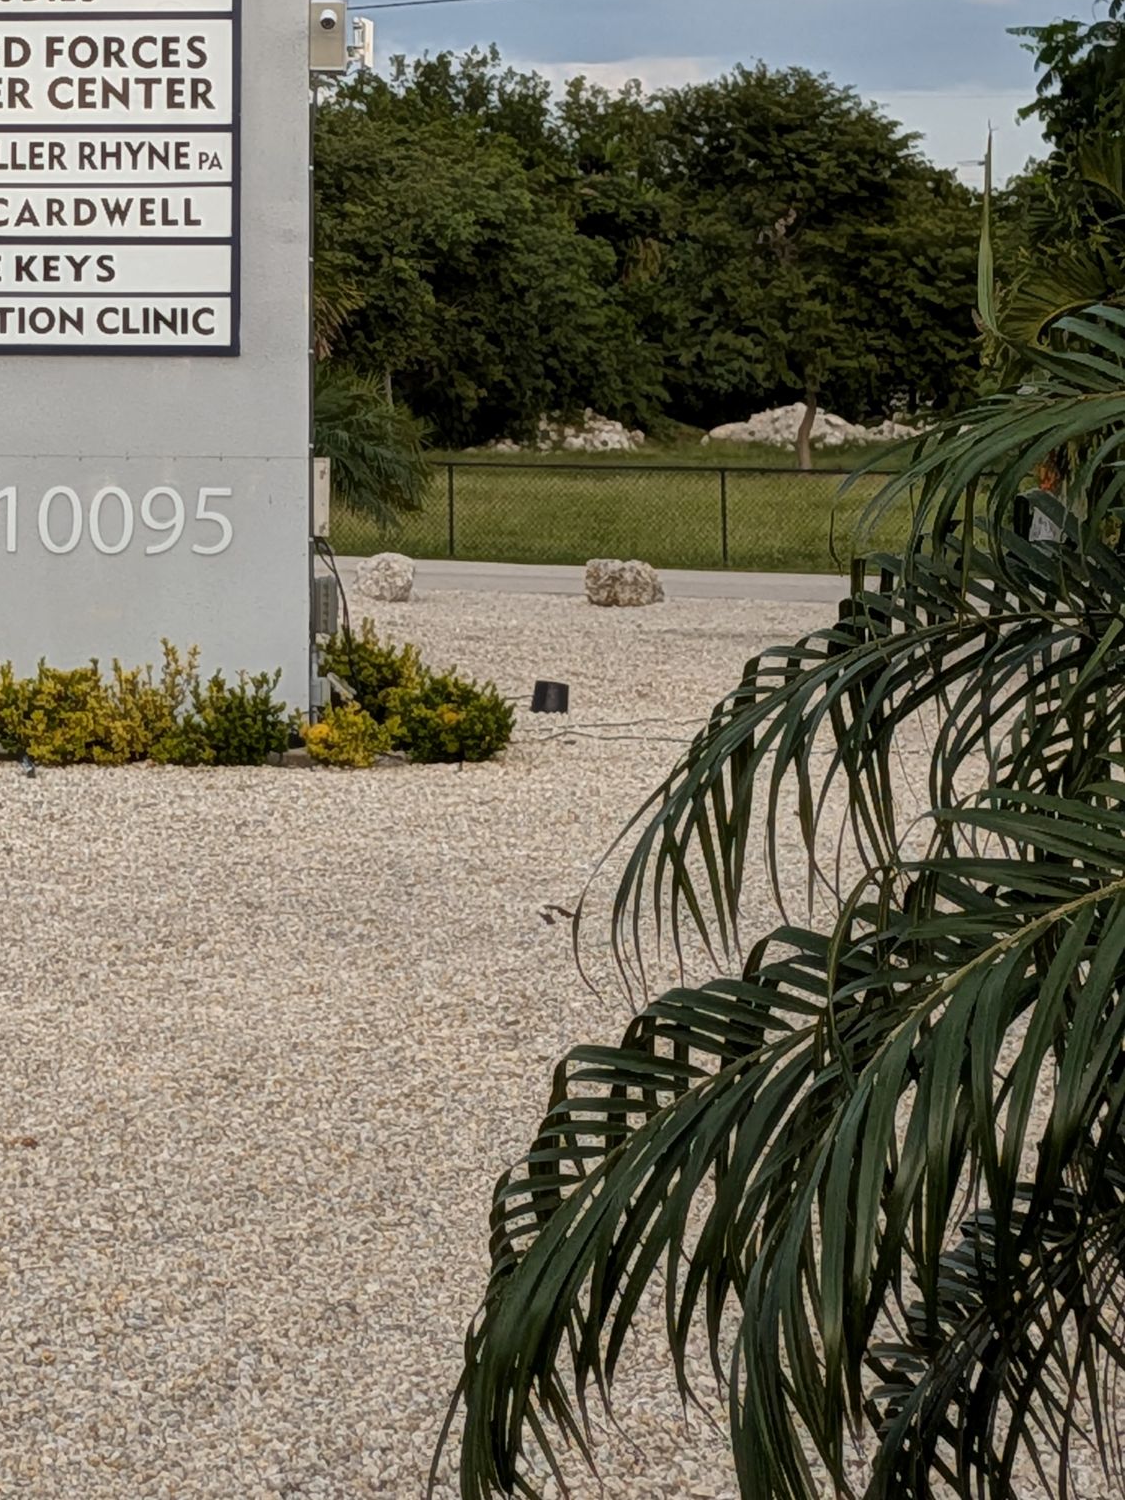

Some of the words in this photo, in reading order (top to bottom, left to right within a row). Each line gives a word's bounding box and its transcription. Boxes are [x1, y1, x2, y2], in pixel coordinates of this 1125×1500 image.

[46, 36, 207, 68] FORCES
[48, 77, 215, 109] CENTER
[79, 142, 190, 170] RHYNE
[199, 152, 222, 169] PA
[16, 255, 115, 282] KEYS
[97, 307, 214, 335] CLINIC
